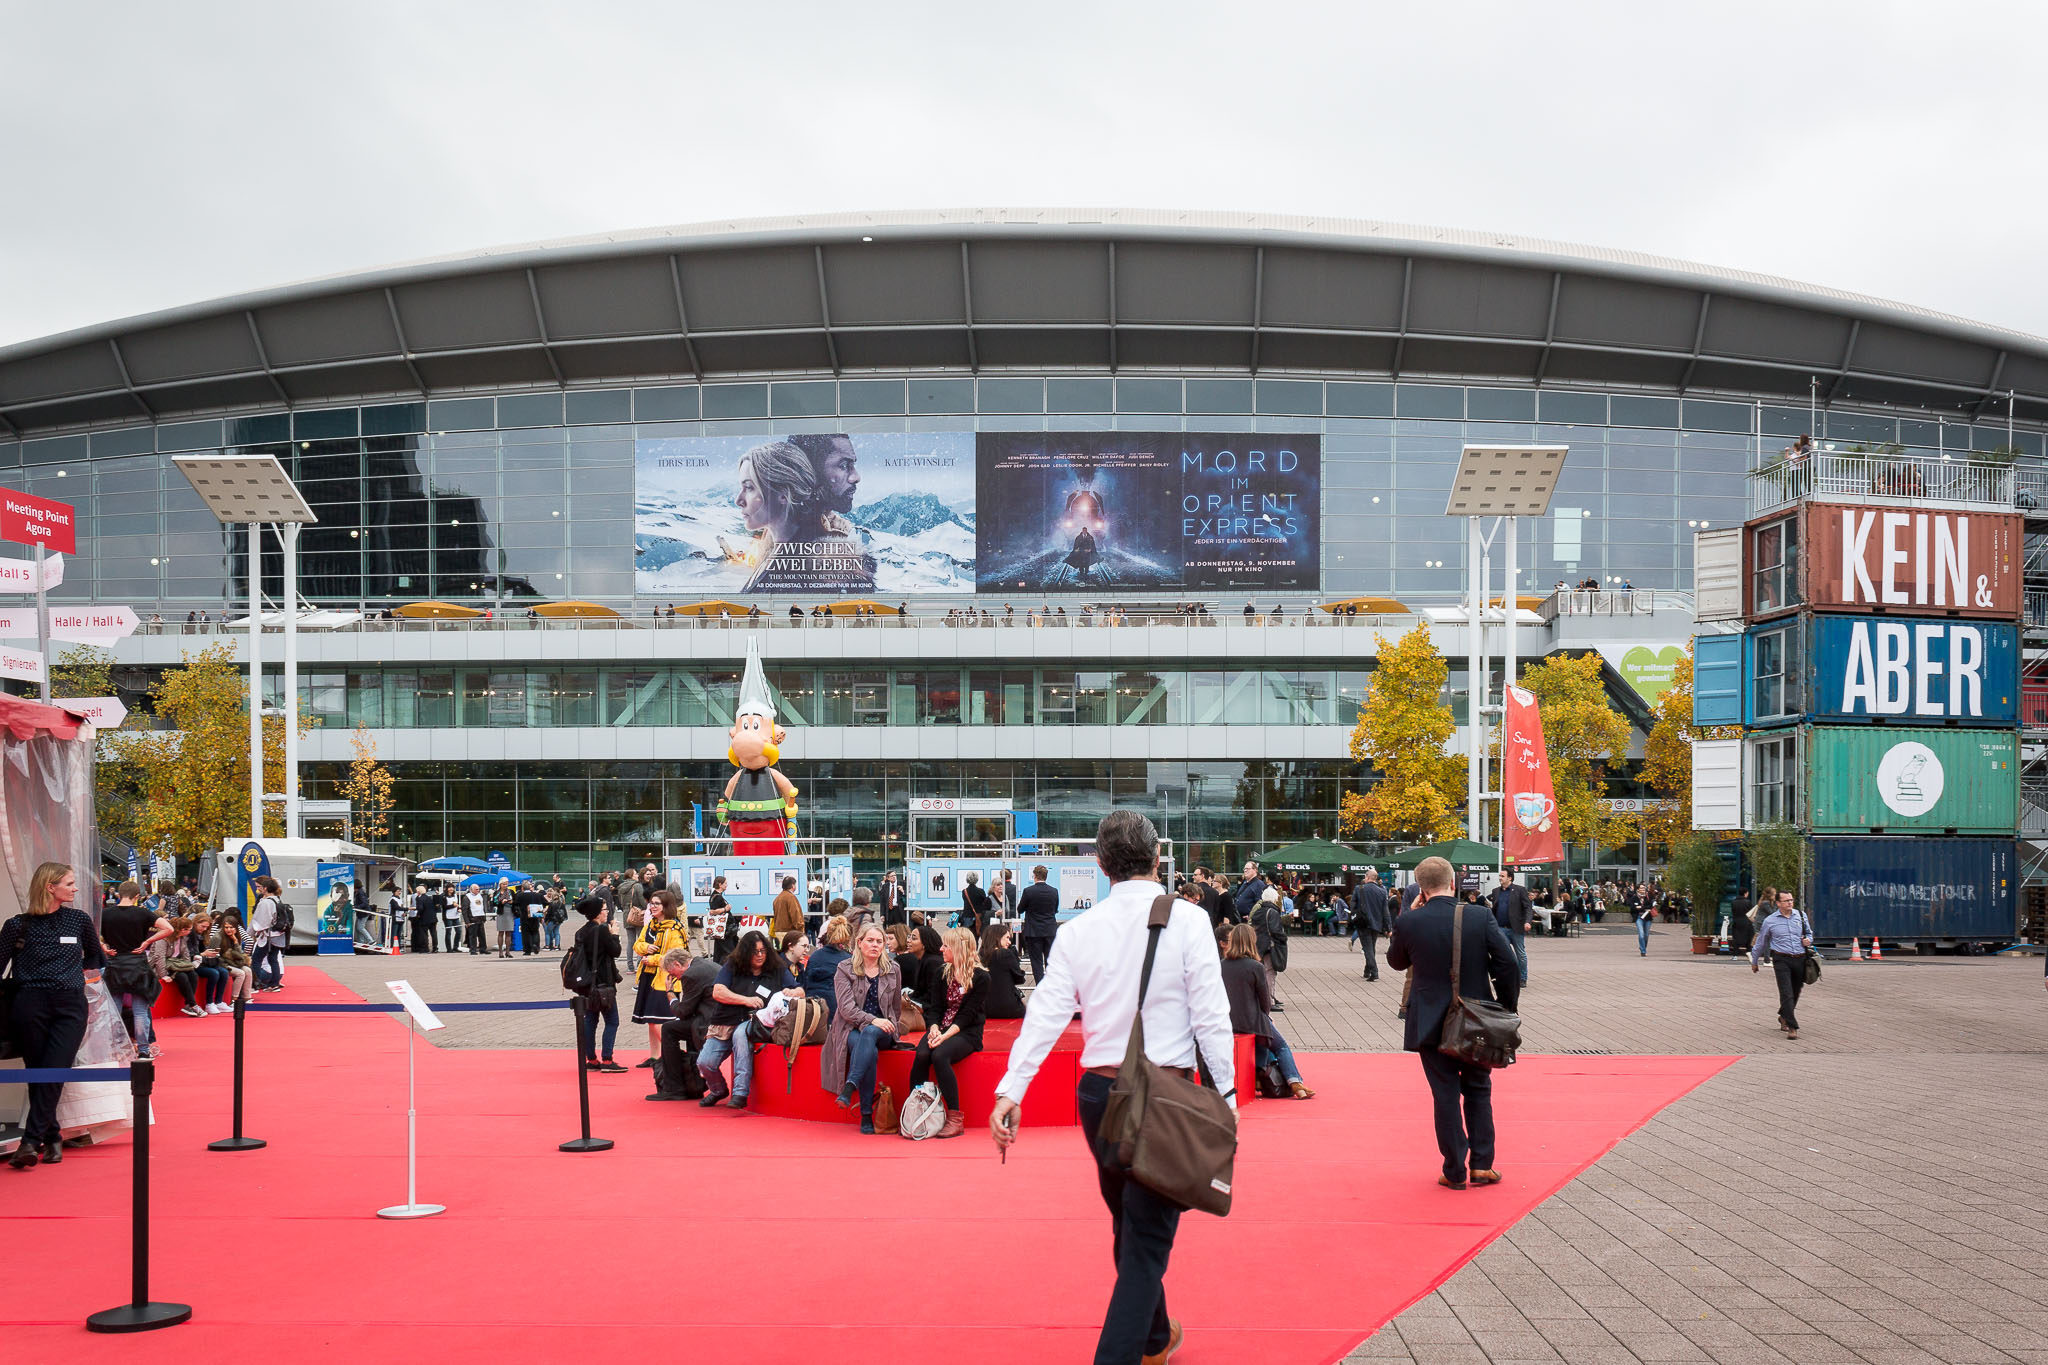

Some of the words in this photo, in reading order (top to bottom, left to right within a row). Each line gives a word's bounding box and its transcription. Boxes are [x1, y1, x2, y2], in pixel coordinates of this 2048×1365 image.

[658, 459, 684, 468] IDRIS
[686, 459, 710, 468] ELBA
[885, 458, 910, 467] KATE
[911, 458, 956, 467] WINSLET
[1183, 451, 1298, 473] MORD
[1231, 477, 1249, 490] IM
[1183, 494, 1298, 513] ORIENT
[6, 500, 44, 521] Meeting
[45, 510, 70, 526] Point
[26, 521, 52, 537] Agora
[1183, 517, 1298, 536] EXPRESS
[773, 542, 857, 556] ZWISCHEN
[765, 558, 807, 572] ZWEI
[812, 558, 864, 572] LEBEN
[1197, 560, 1247, 568] DONNERSTAG,
[1842, 510, 1969, 607] KEIN
[1975, 574, 1994, 608] &
[23, 569, 30, 581] 5
[55, 616, 82, 627] Halle
[85, 616, 89, 627] /
[93, 616, 114, 627] Hall
[116, 616, 124, 627] 4
[3, 655, 38, 671] Signierzelt
[1842, 621, 1983, 717] ABER
[1285, 863, 1311, 871] BECK'S
[1350, 864, 1376, 872] BECK'S
[1469, 864, 1490, 872] BECK'S
